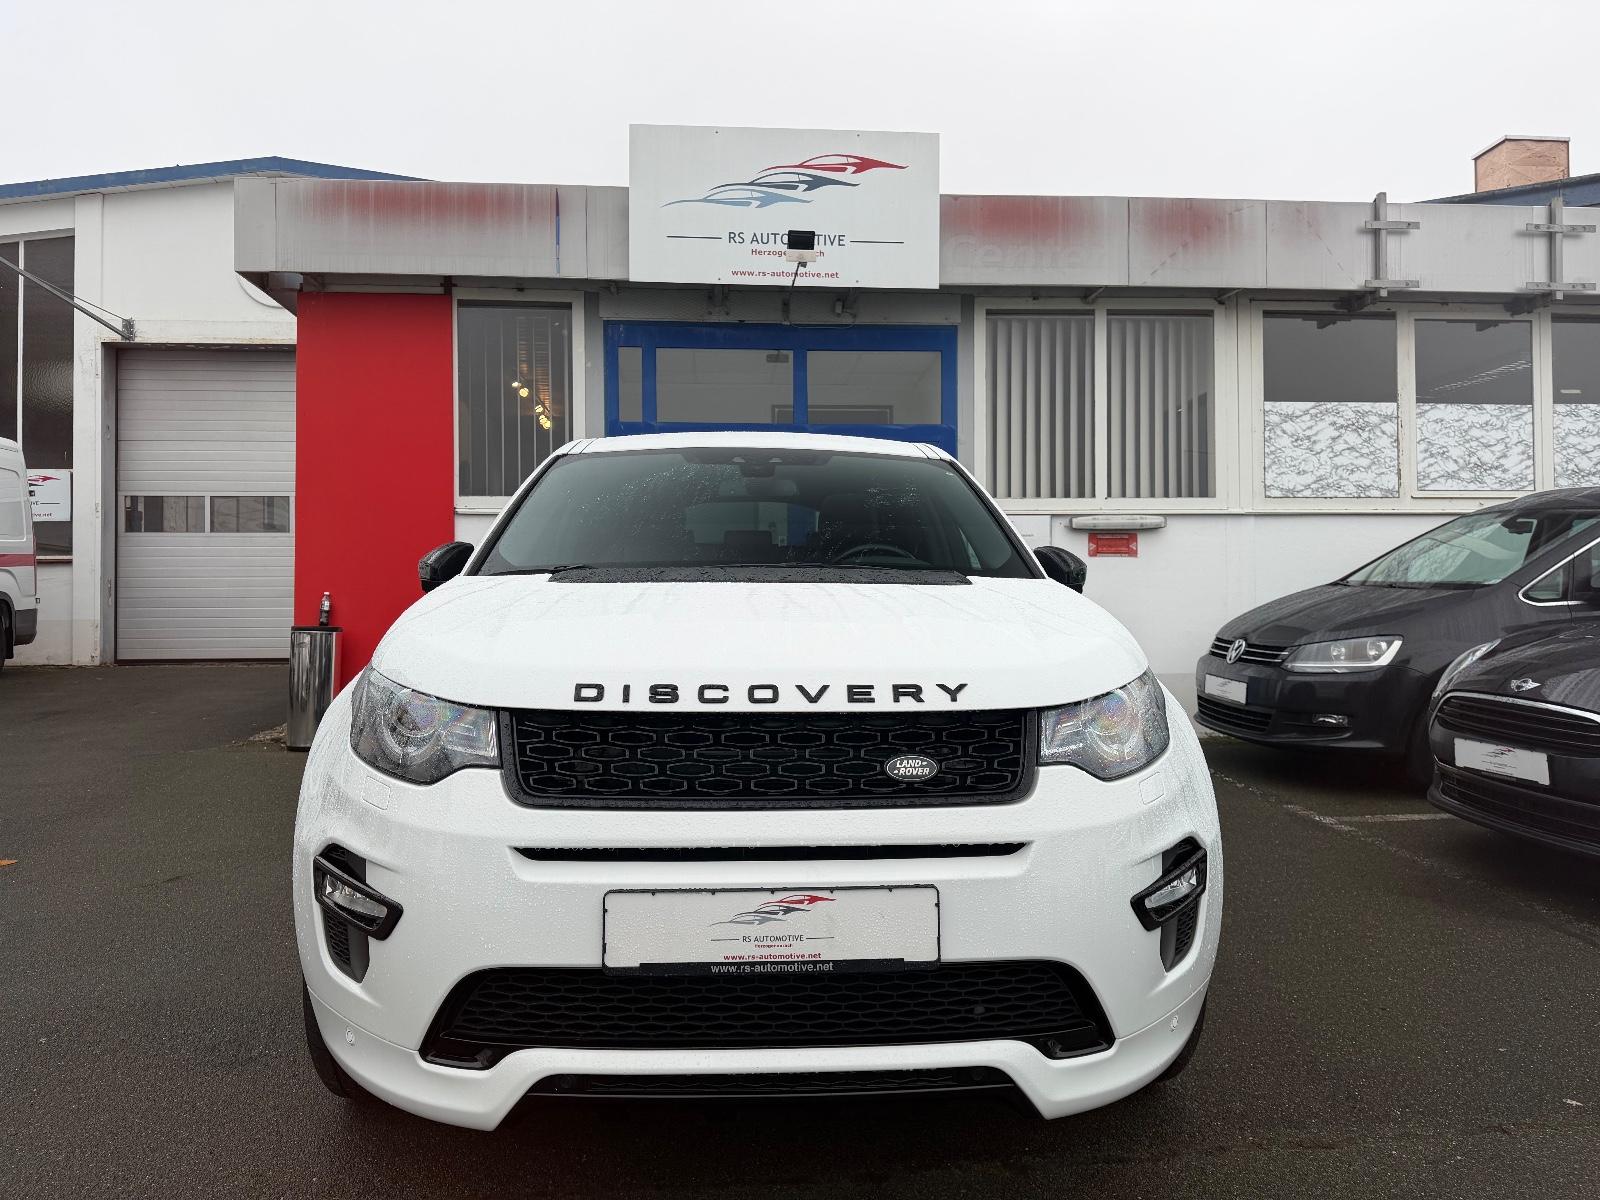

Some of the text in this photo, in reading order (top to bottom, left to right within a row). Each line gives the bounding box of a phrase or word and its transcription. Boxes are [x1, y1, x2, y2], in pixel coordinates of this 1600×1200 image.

[728, 231, 846, 247] RS AUTOTIVE
[731, 269, 840, 279] www.rs-automotive.net
[573, 683, 969, 704] DISCOVERY
[742, 934, 804, 943] RS AUTOMOTIVE
[723, 952, 822, 961] www.rs-automotive.net
[710, 962, 834, 973] www.rs-automotive.net
